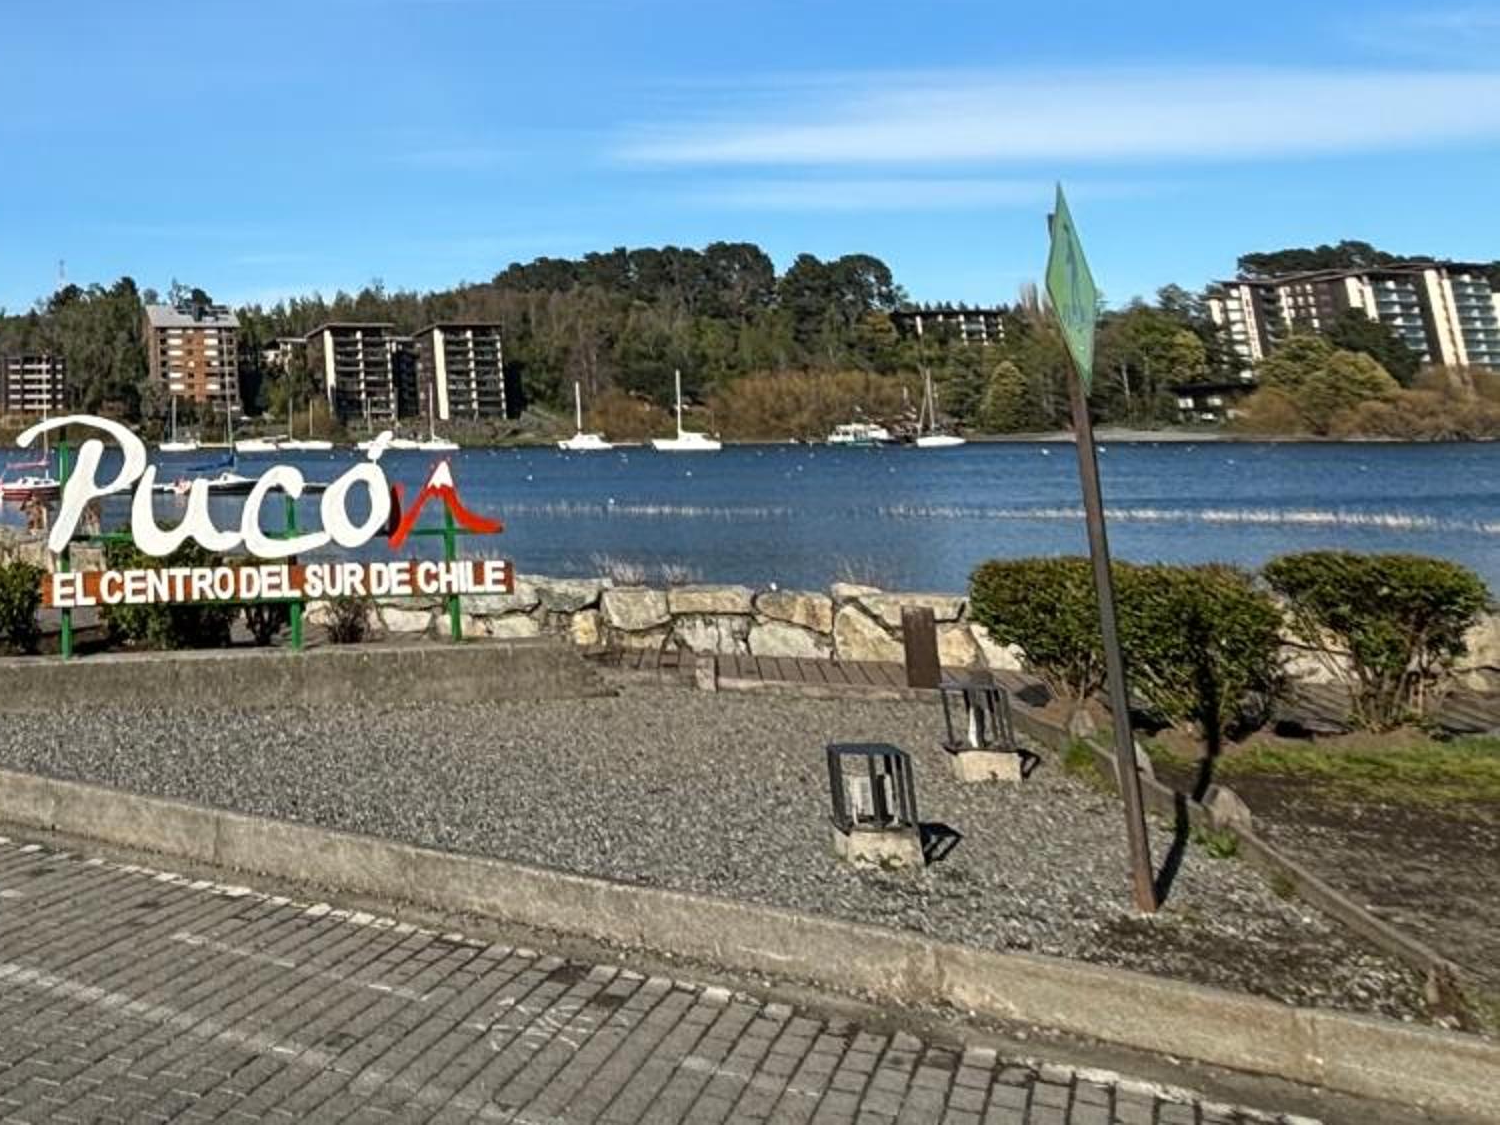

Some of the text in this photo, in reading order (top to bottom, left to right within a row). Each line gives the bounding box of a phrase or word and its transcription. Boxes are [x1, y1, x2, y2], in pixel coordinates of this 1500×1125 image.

[16, 414, 504, 558] Pucón
[53, 559, 507, 607] EL CENTRO DEL SUR DE CHILE
